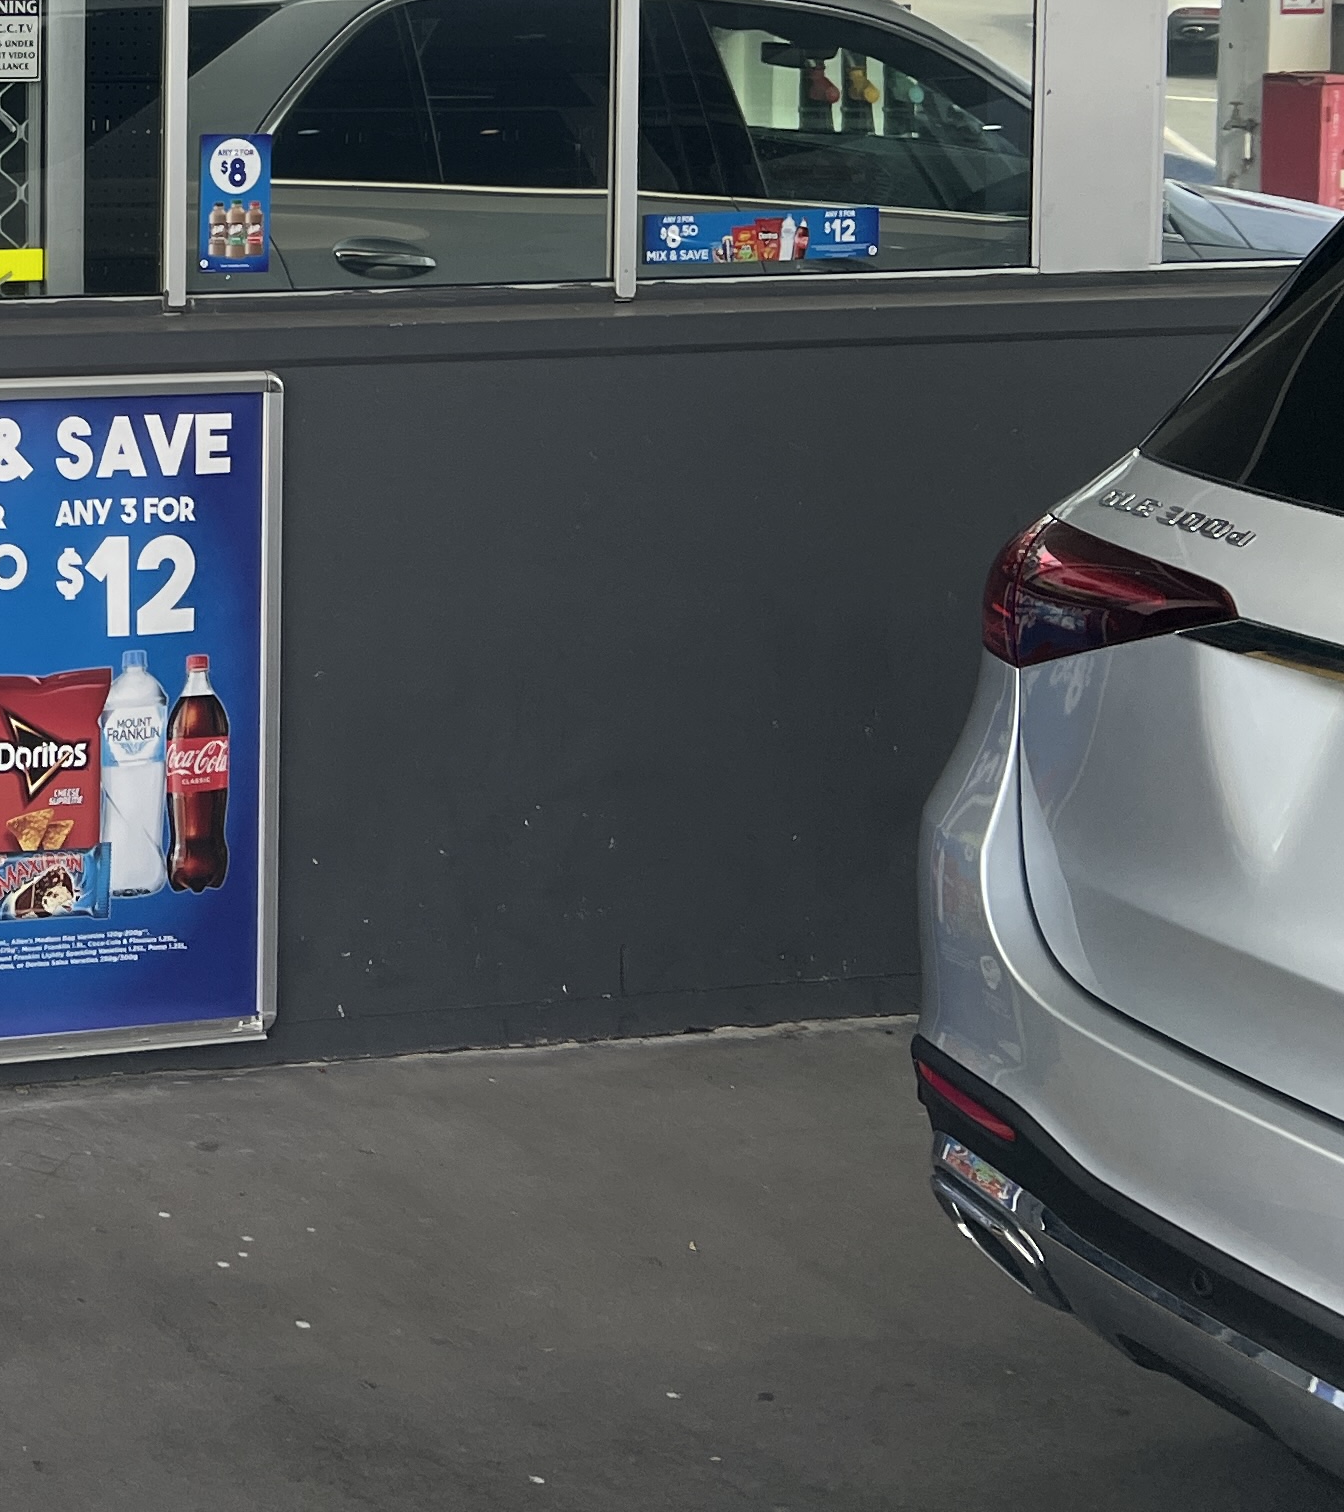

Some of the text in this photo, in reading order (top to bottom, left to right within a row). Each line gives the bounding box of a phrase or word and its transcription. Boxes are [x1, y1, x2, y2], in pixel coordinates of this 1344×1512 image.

[4, 39, 34, 48] UNDER
[8, 51, 36, 60] VIDEO
[220, 157, 247, 187] $8
[659, 224, 699, 248] $8.50
[823, 218, 856, 243] $12
[645, 248, 709, 262] MIX & SAVE
[54, 412, 233, 481] SAVE
[54, 495, 196, 527] ANY 3 FOR
[1098, 489, 1258, 548] GLE 300d
[54, 534, 197, 638] $12
[106, 725, 162, 743] FRANKLIN
[116, 716, 152, 728] MOUNT
[166, 739, 229, 776] Coca-Cola
[53, 787, 81, 798] CHEESE
[181, 776, 211, 786] CLASSIC
